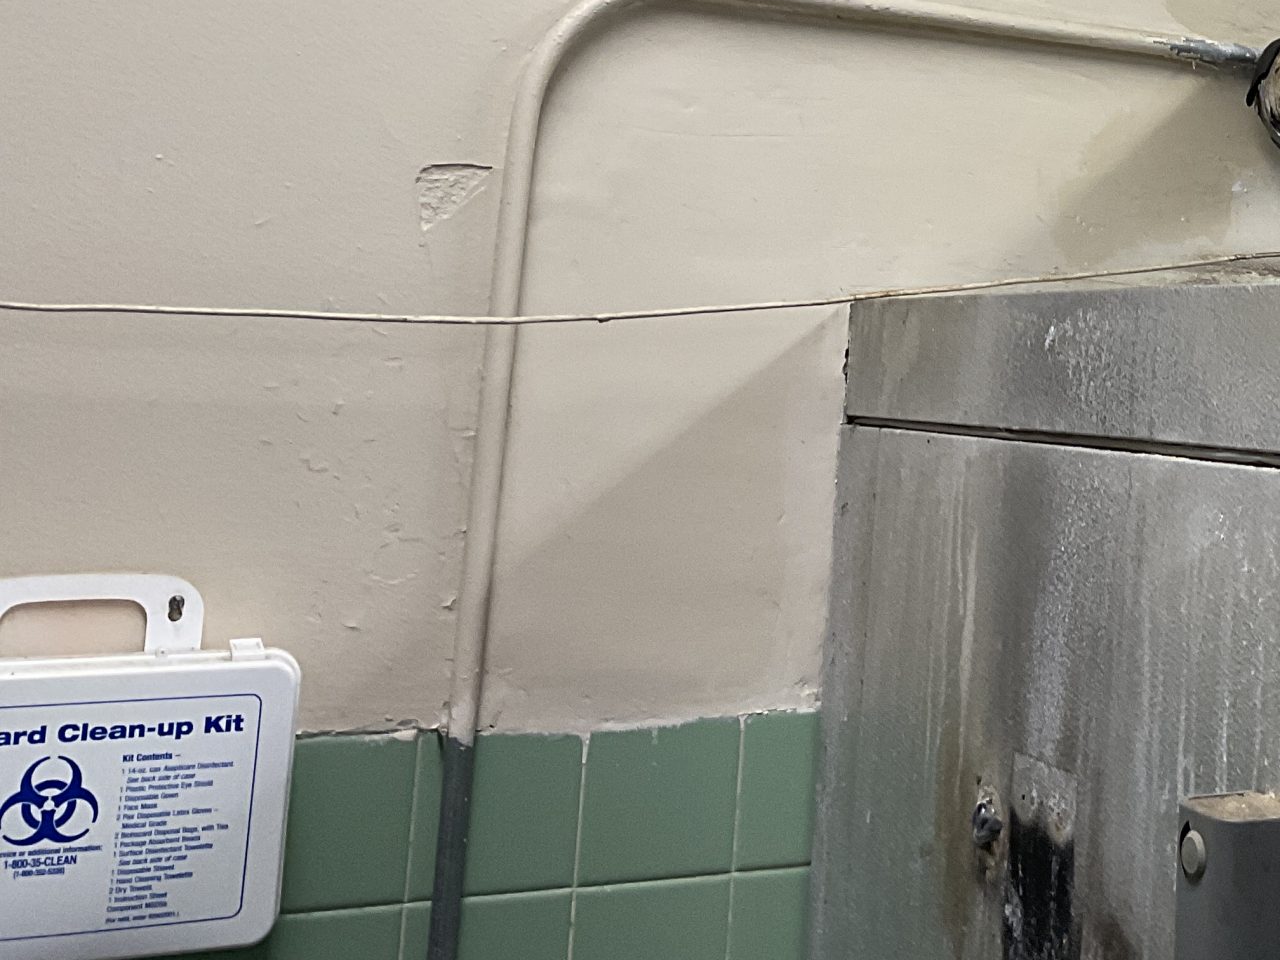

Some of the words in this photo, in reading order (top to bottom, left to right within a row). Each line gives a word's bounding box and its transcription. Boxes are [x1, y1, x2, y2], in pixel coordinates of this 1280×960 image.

[58, 721, 193, 742] Clean-up
[204, 714, 244, 733] Kit
[123, 754, 134, 762] Kit
[137, 753, 172, 761] Contents
[4, 855, 77, 869] 1-800-35-CLEAN
